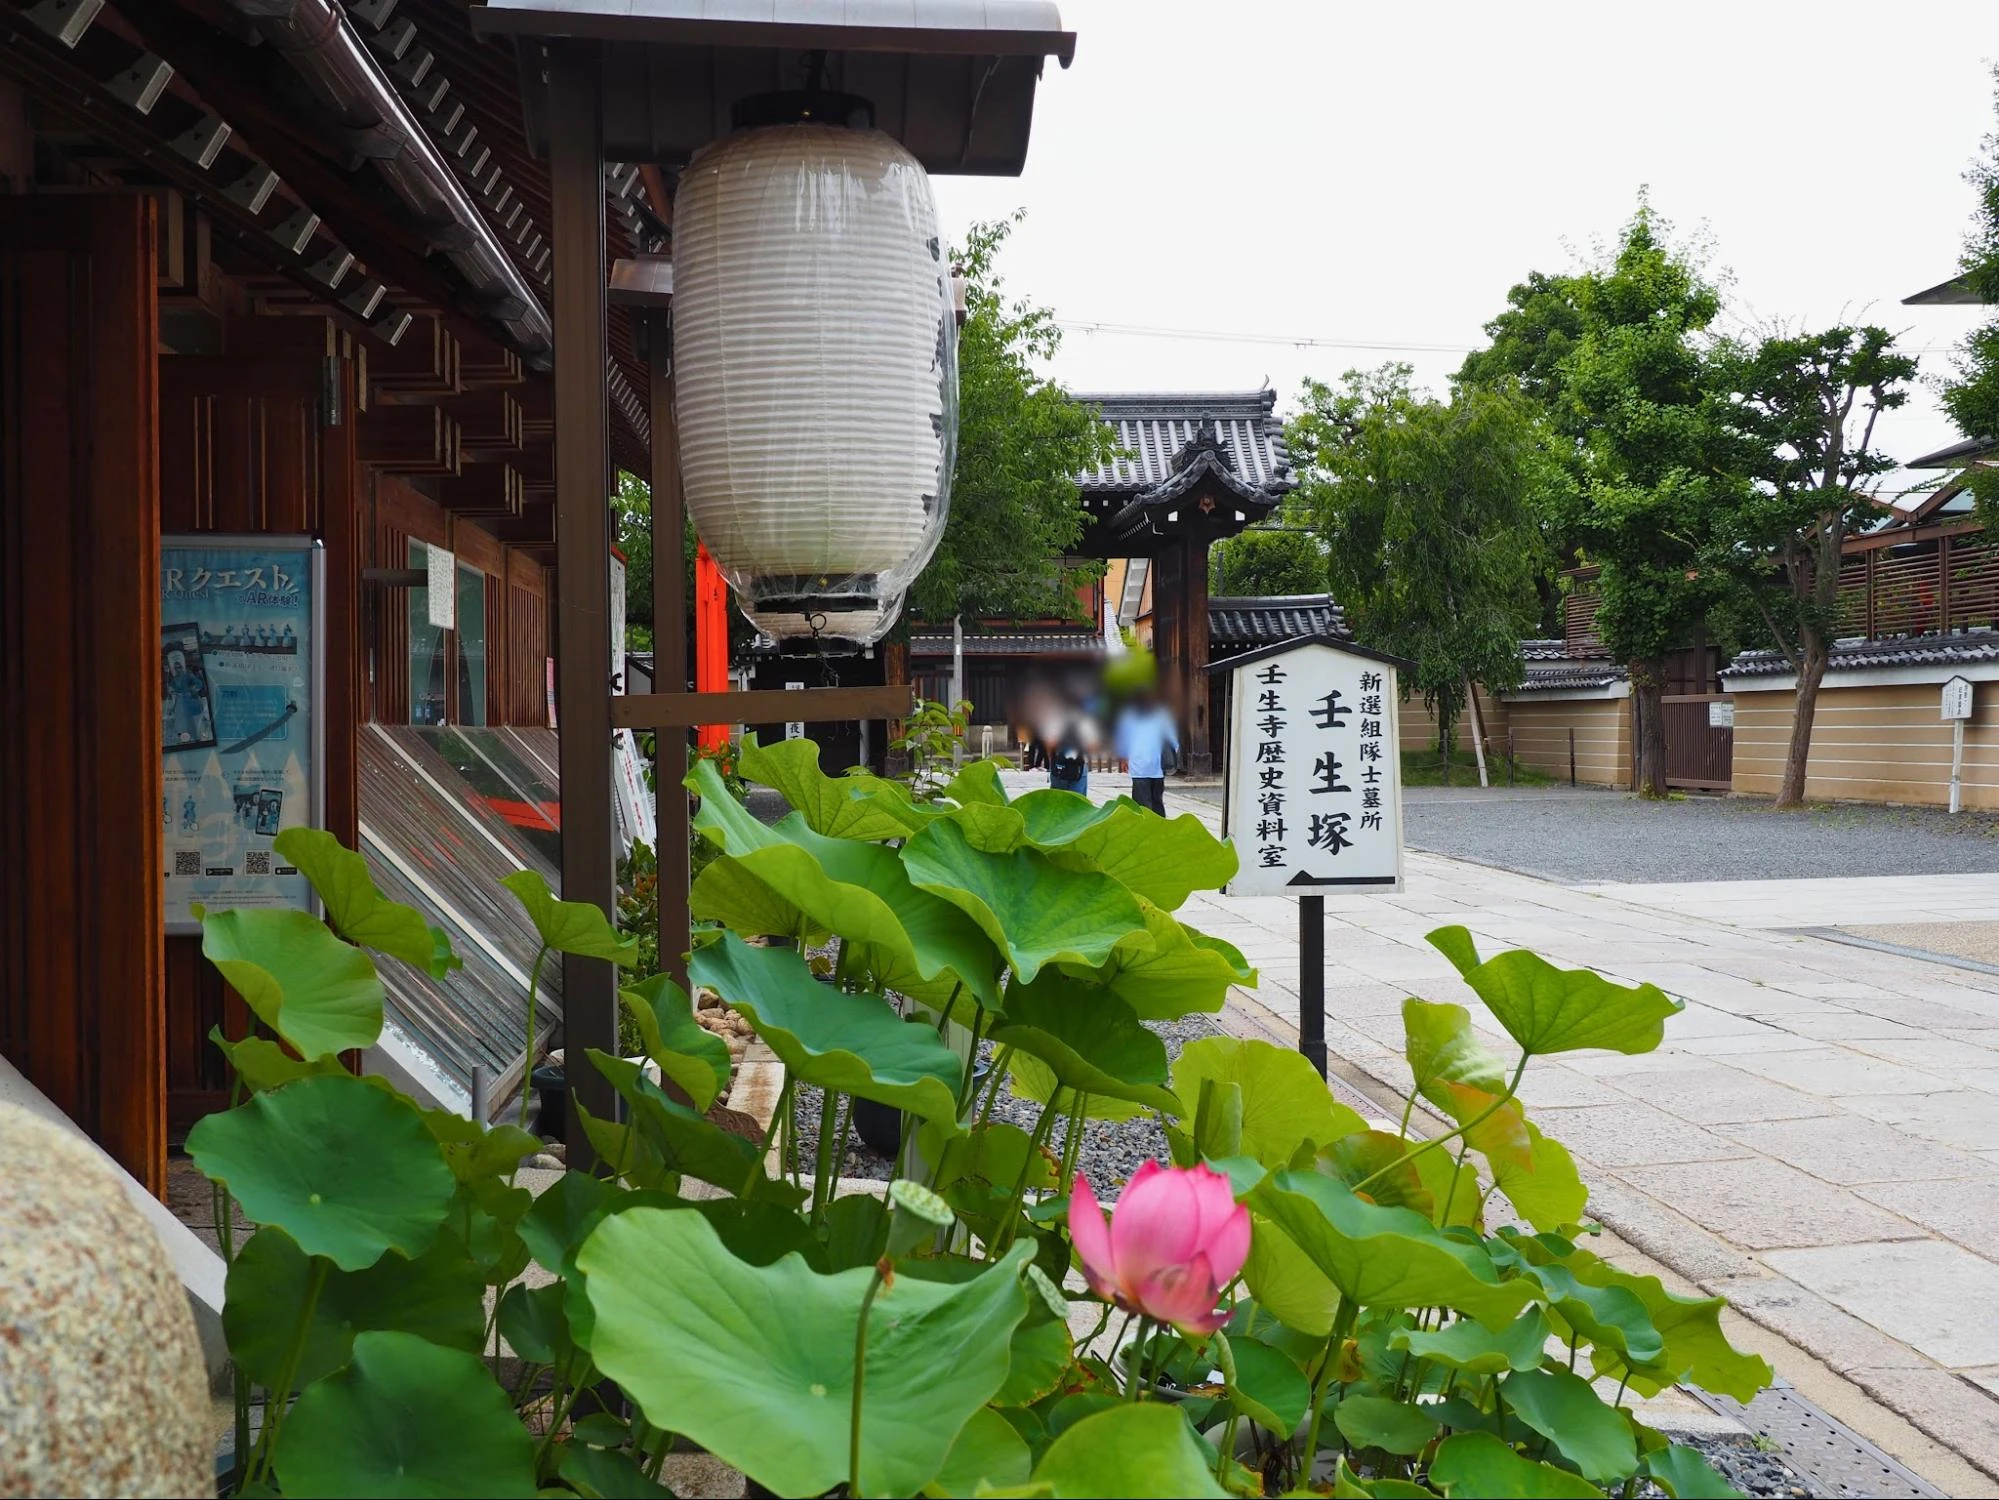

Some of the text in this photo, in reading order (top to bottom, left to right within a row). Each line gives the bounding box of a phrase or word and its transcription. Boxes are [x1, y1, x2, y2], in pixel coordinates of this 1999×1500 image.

[1255, 663, 1289, 868] 壬生寺歴史資料室
[1307, 689, 1354, 856] 壬生塚
[1359, 671, 1383, 832] 新選組隊士墓所
